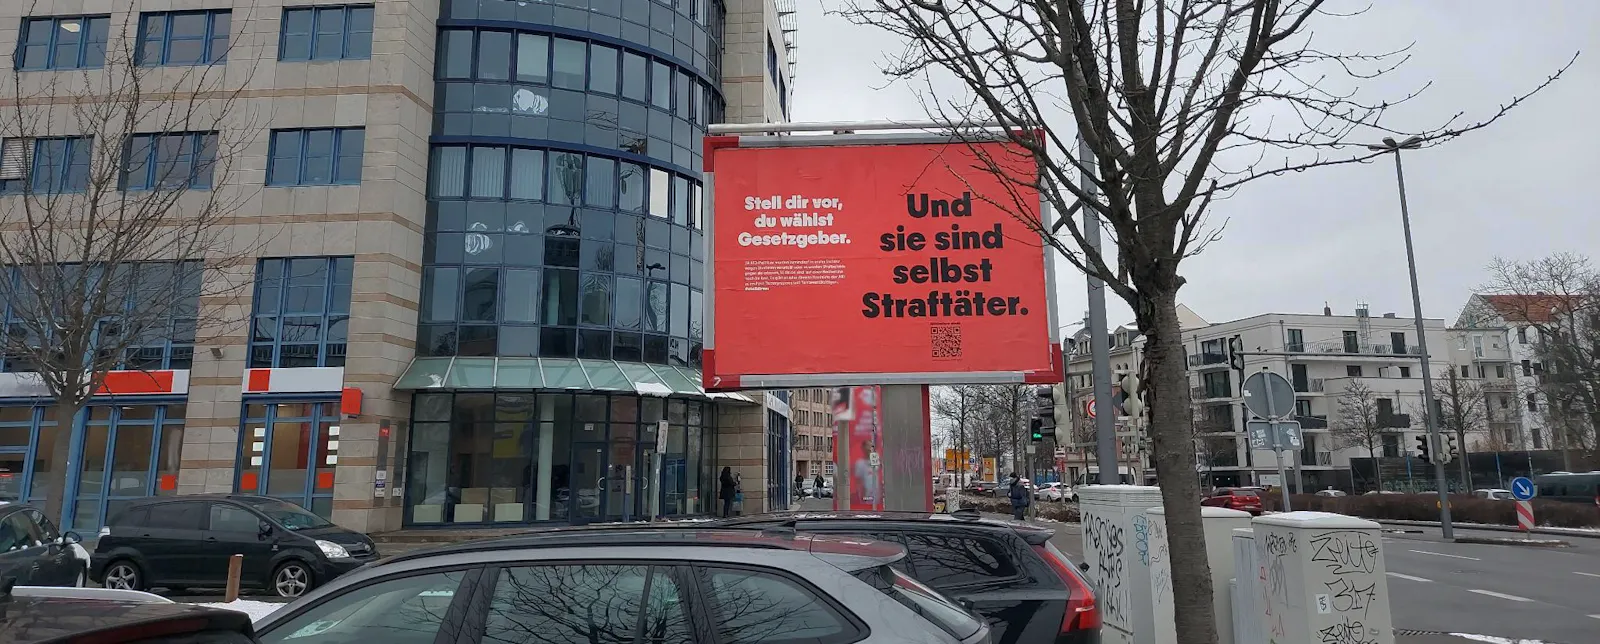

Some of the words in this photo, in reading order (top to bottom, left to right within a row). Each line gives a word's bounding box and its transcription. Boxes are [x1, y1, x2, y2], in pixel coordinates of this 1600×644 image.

[744, 195, 782, 211] Stell
[785, 194, 809, 210] dir
[811, 197, 843, 214] vor,
[906, 188, 972, 219] Und
[754, 213, 777, 228] du
[779, 212, 834, 228] wählst
[737, 230, 851, 249] Gesetzgeber.
[879, 224, 927, 252] sie
[934, 222, 1004, 251] sind
[892, 256, 993, 285] selbst
[861, 289, 1029, 319] Straftäter.
